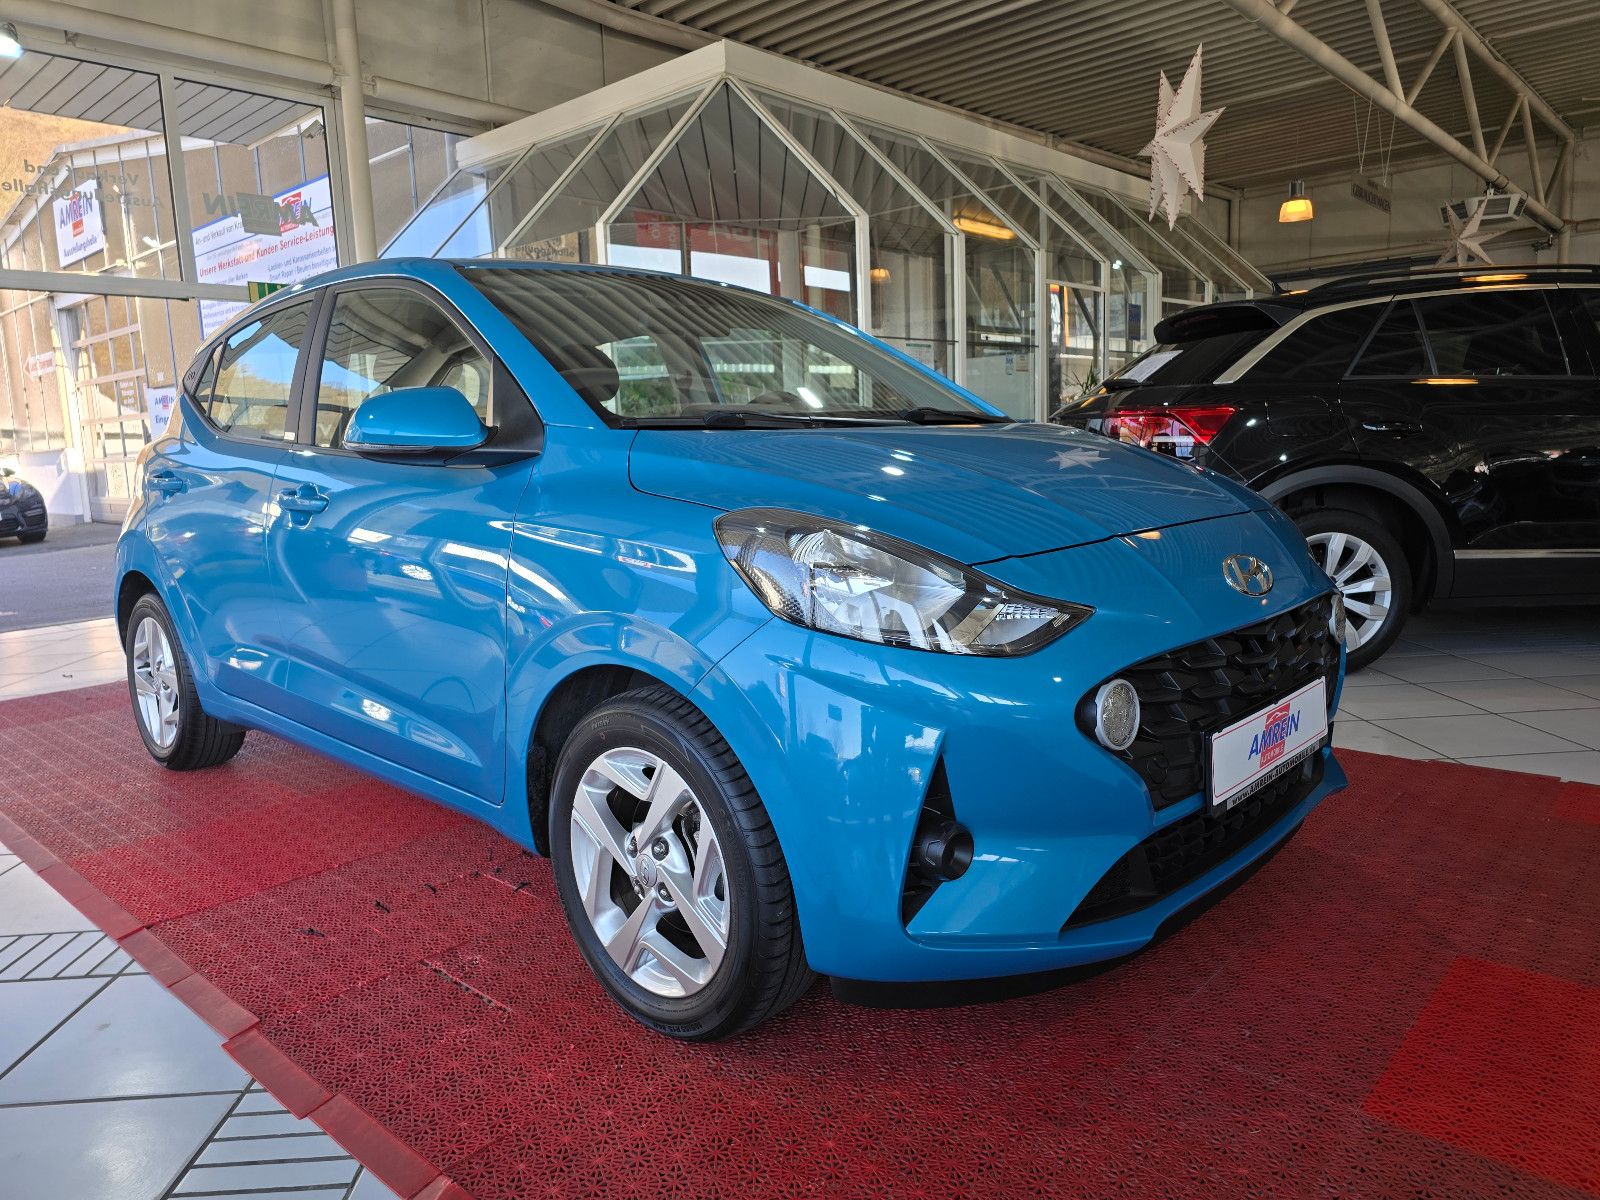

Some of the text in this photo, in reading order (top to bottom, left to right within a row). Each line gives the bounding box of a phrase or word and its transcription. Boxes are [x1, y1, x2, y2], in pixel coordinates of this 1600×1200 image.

[59, 191, 94, 229] AMREIN
[199, 265, 217, 277] Unsere
[256, 245, 279, 259] Kunden
[1248, 710, 1300, 760] AMREIN
